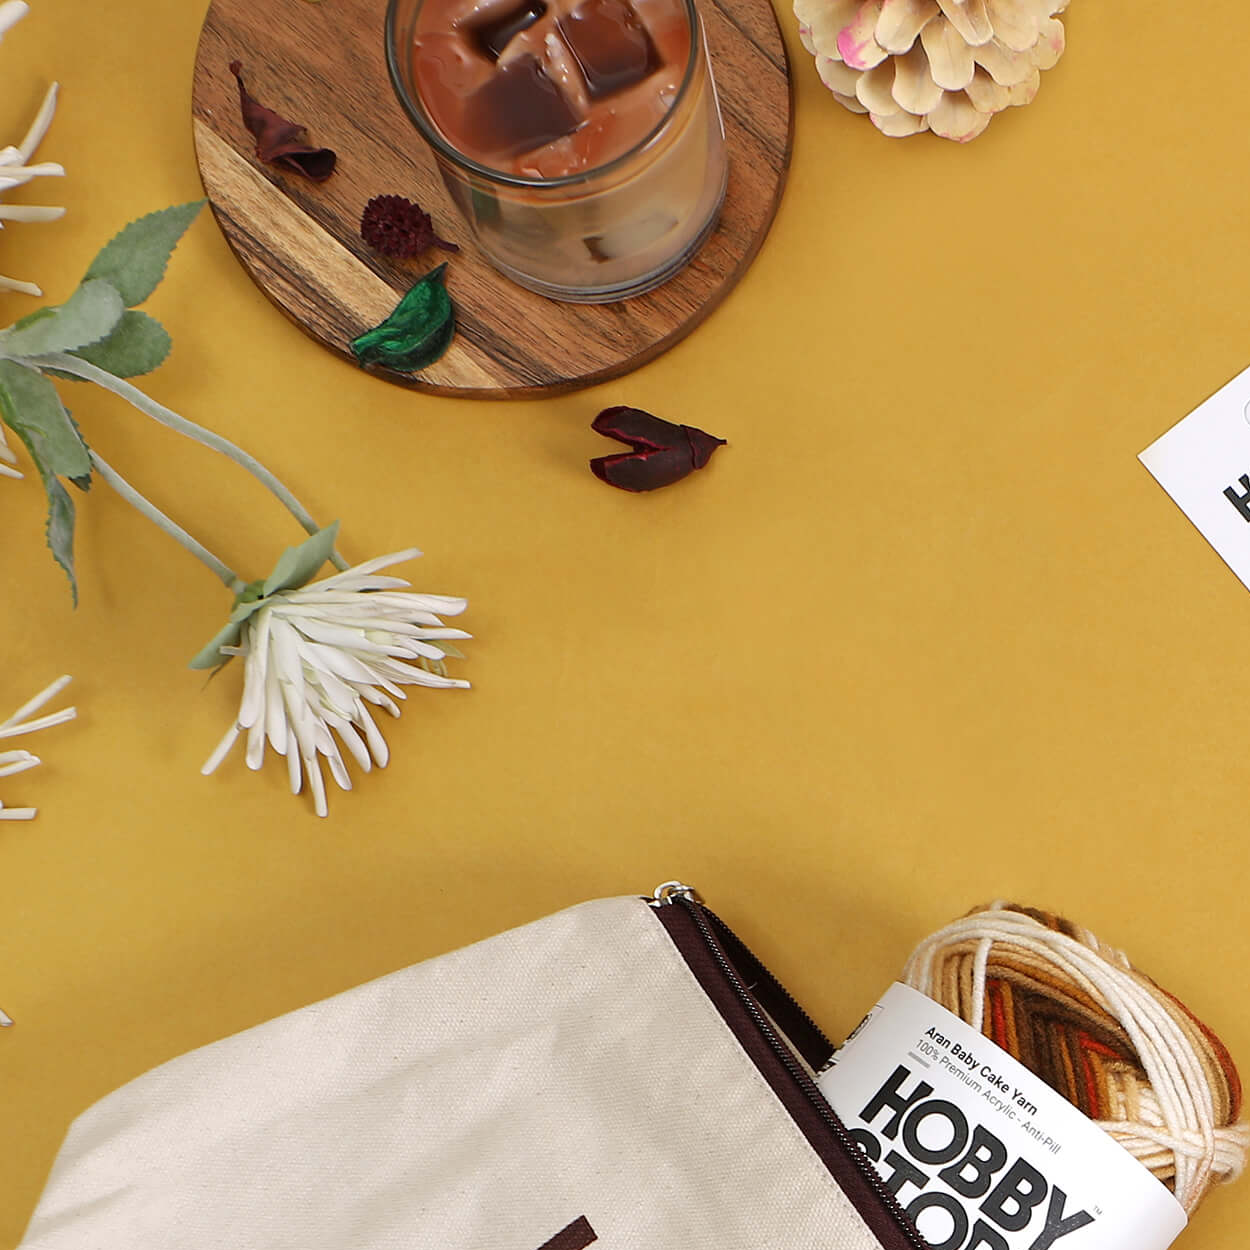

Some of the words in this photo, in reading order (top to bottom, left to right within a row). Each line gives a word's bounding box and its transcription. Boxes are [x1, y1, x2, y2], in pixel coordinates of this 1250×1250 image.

[915, 1039, 940, 1061] 100%
[938, 1056, 983, 1093] Premium
[981, 1089, 1017, 1120] Acrylic
[924, 1026, 951, 1049] Aran
[949, 1043, 981, 1071] Baby
[979, 1065, 1010, 1093] Cake
[1010, 1088, 1038, 1116] Yarn
